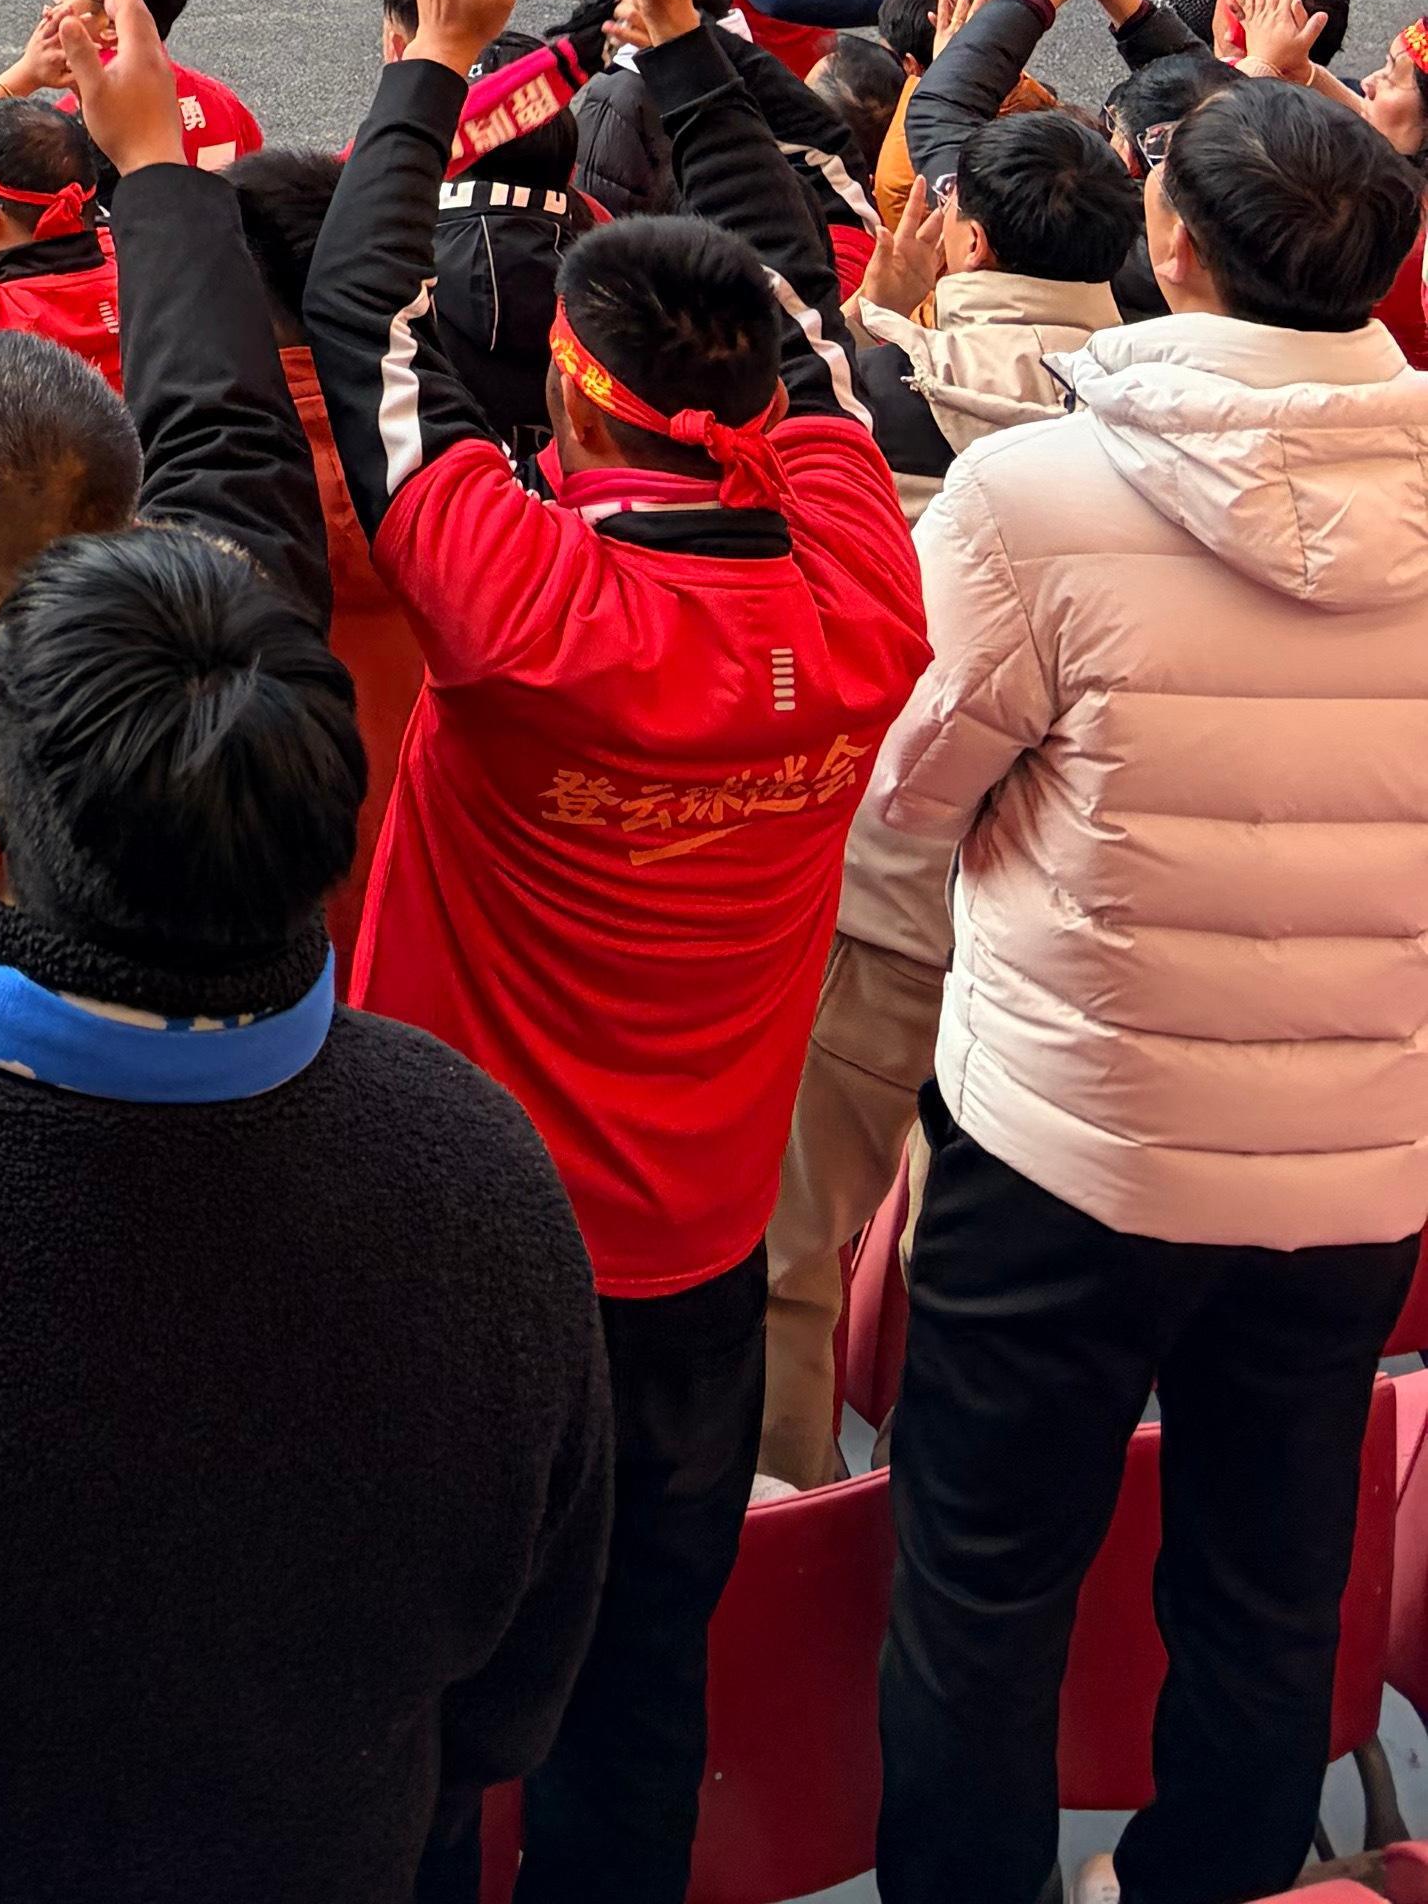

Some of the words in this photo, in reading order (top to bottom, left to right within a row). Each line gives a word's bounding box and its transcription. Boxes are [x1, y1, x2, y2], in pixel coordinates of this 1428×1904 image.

[538, 734, 873, 833] 登云球迷会
